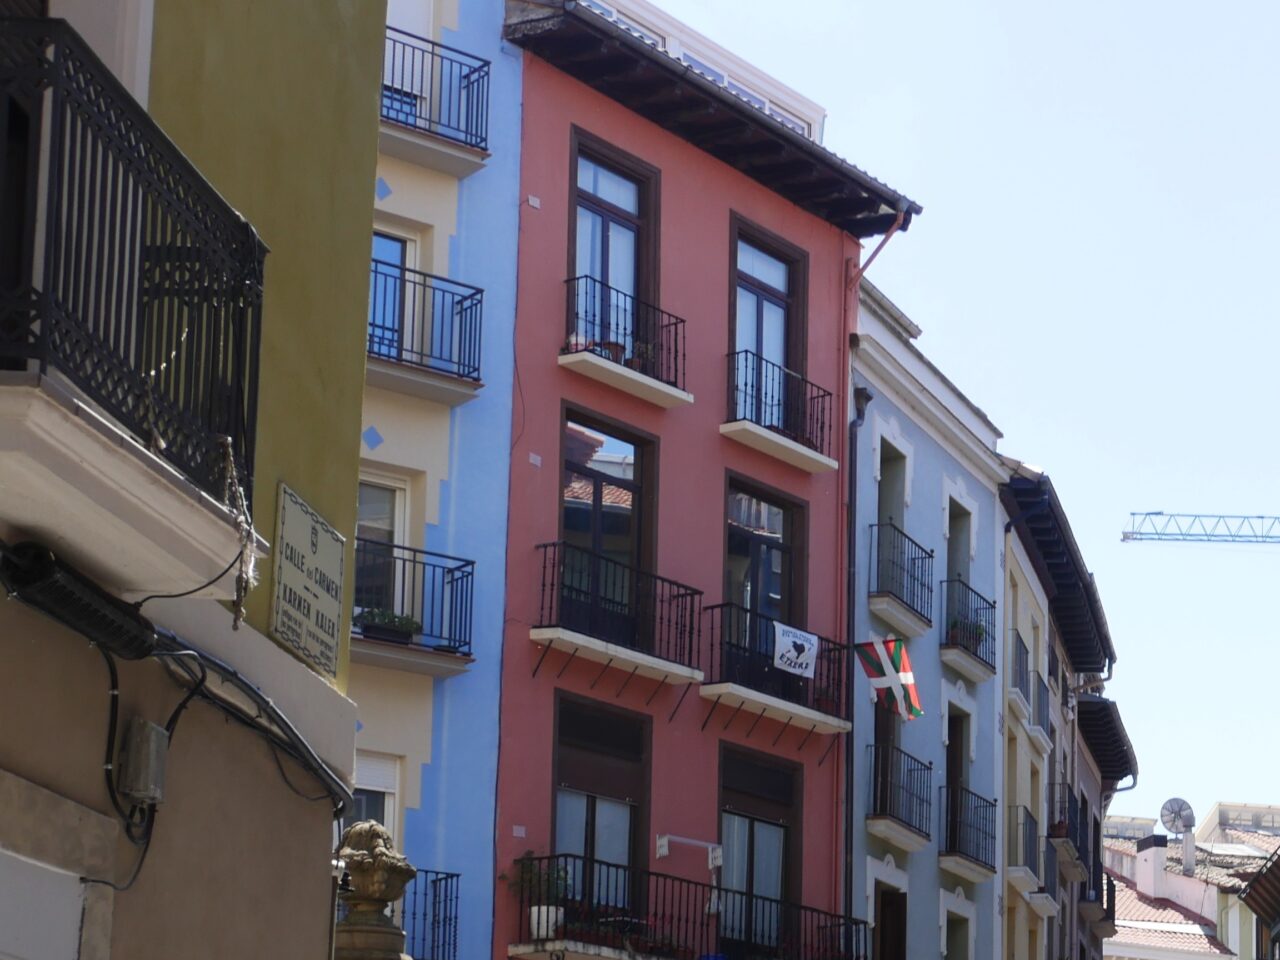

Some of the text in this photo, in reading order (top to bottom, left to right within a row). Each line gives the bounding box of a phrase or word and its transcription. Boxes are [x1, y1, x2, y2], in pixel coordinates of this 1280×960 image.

[285, 542, 306, 574] CALLE
[314, 568, 340, 602] CARMEN
[282, 583, 312, 620] KARMEN
[315, 607, 336, 639] KALEA
